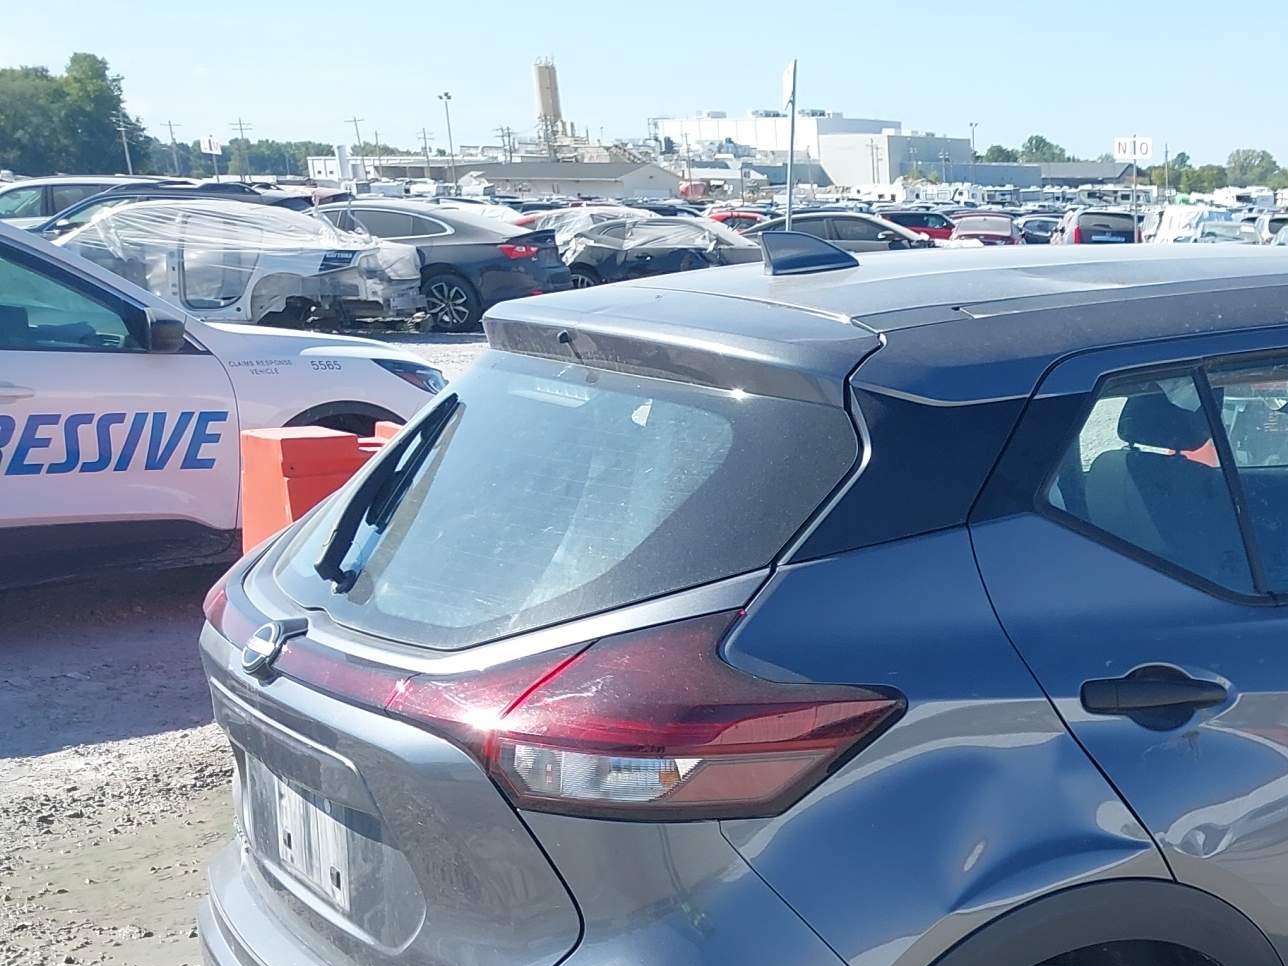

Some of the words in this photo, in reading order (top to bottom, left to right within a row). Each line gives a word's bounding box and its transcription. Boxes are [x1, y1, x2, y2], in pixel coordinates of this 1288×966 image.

[228, 360, 254, 368] CLAIMS
[255, 359, 293, 367] RESPONSE
[310, 360, 342, 371] 5565
[249, 367, 280, 375] VEHICLE
